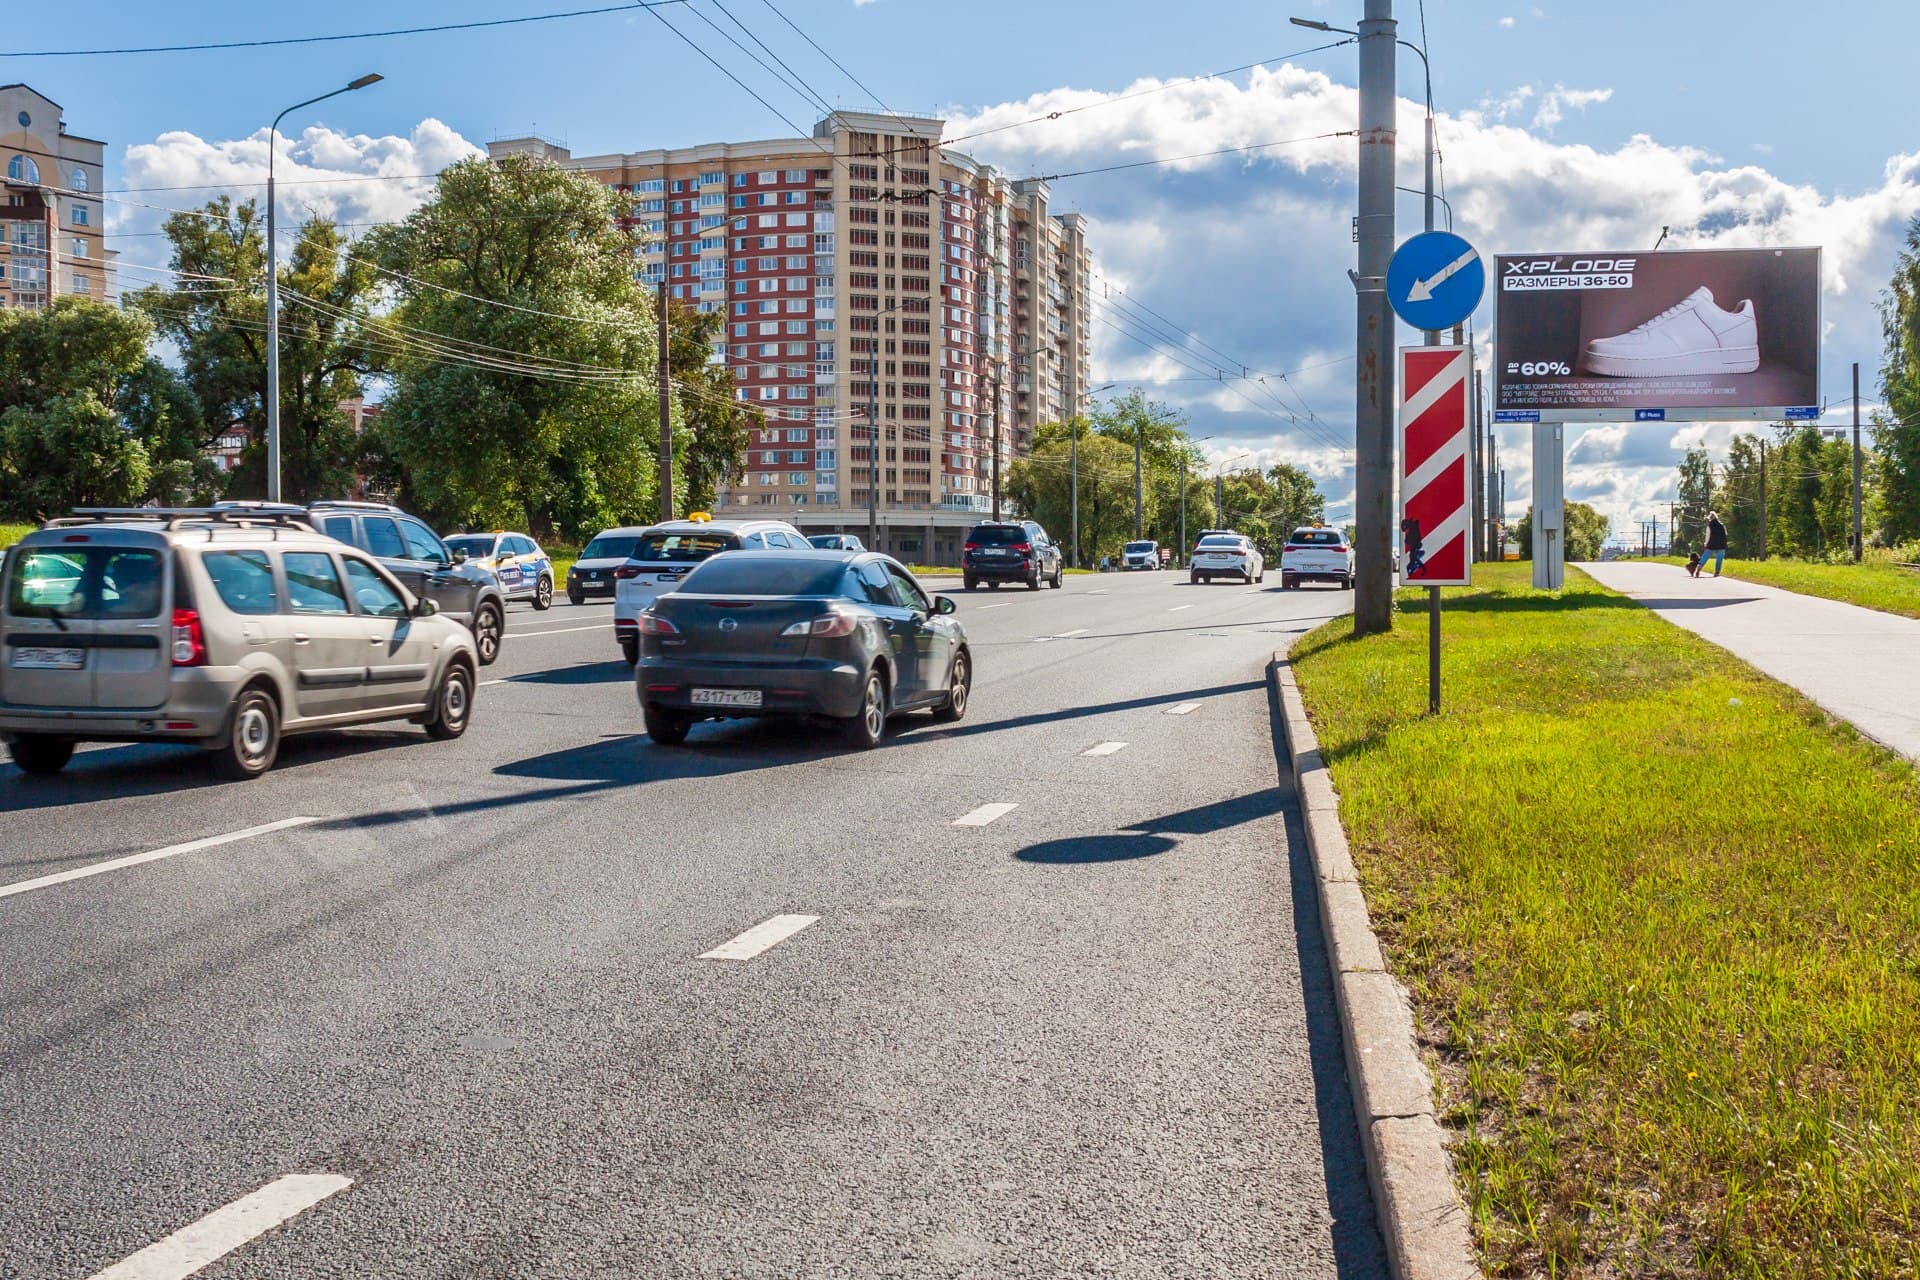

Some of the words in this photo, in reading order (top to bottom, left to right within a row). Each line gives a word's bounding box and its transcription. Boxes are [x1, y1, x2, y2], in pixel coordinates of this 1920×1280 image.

[1505, 259, 1637, 274] X-PLODE
[1507, 277, 1581, 289] РАЗМЕРЫ
[1583, 276, 1629, 287] 36-50
